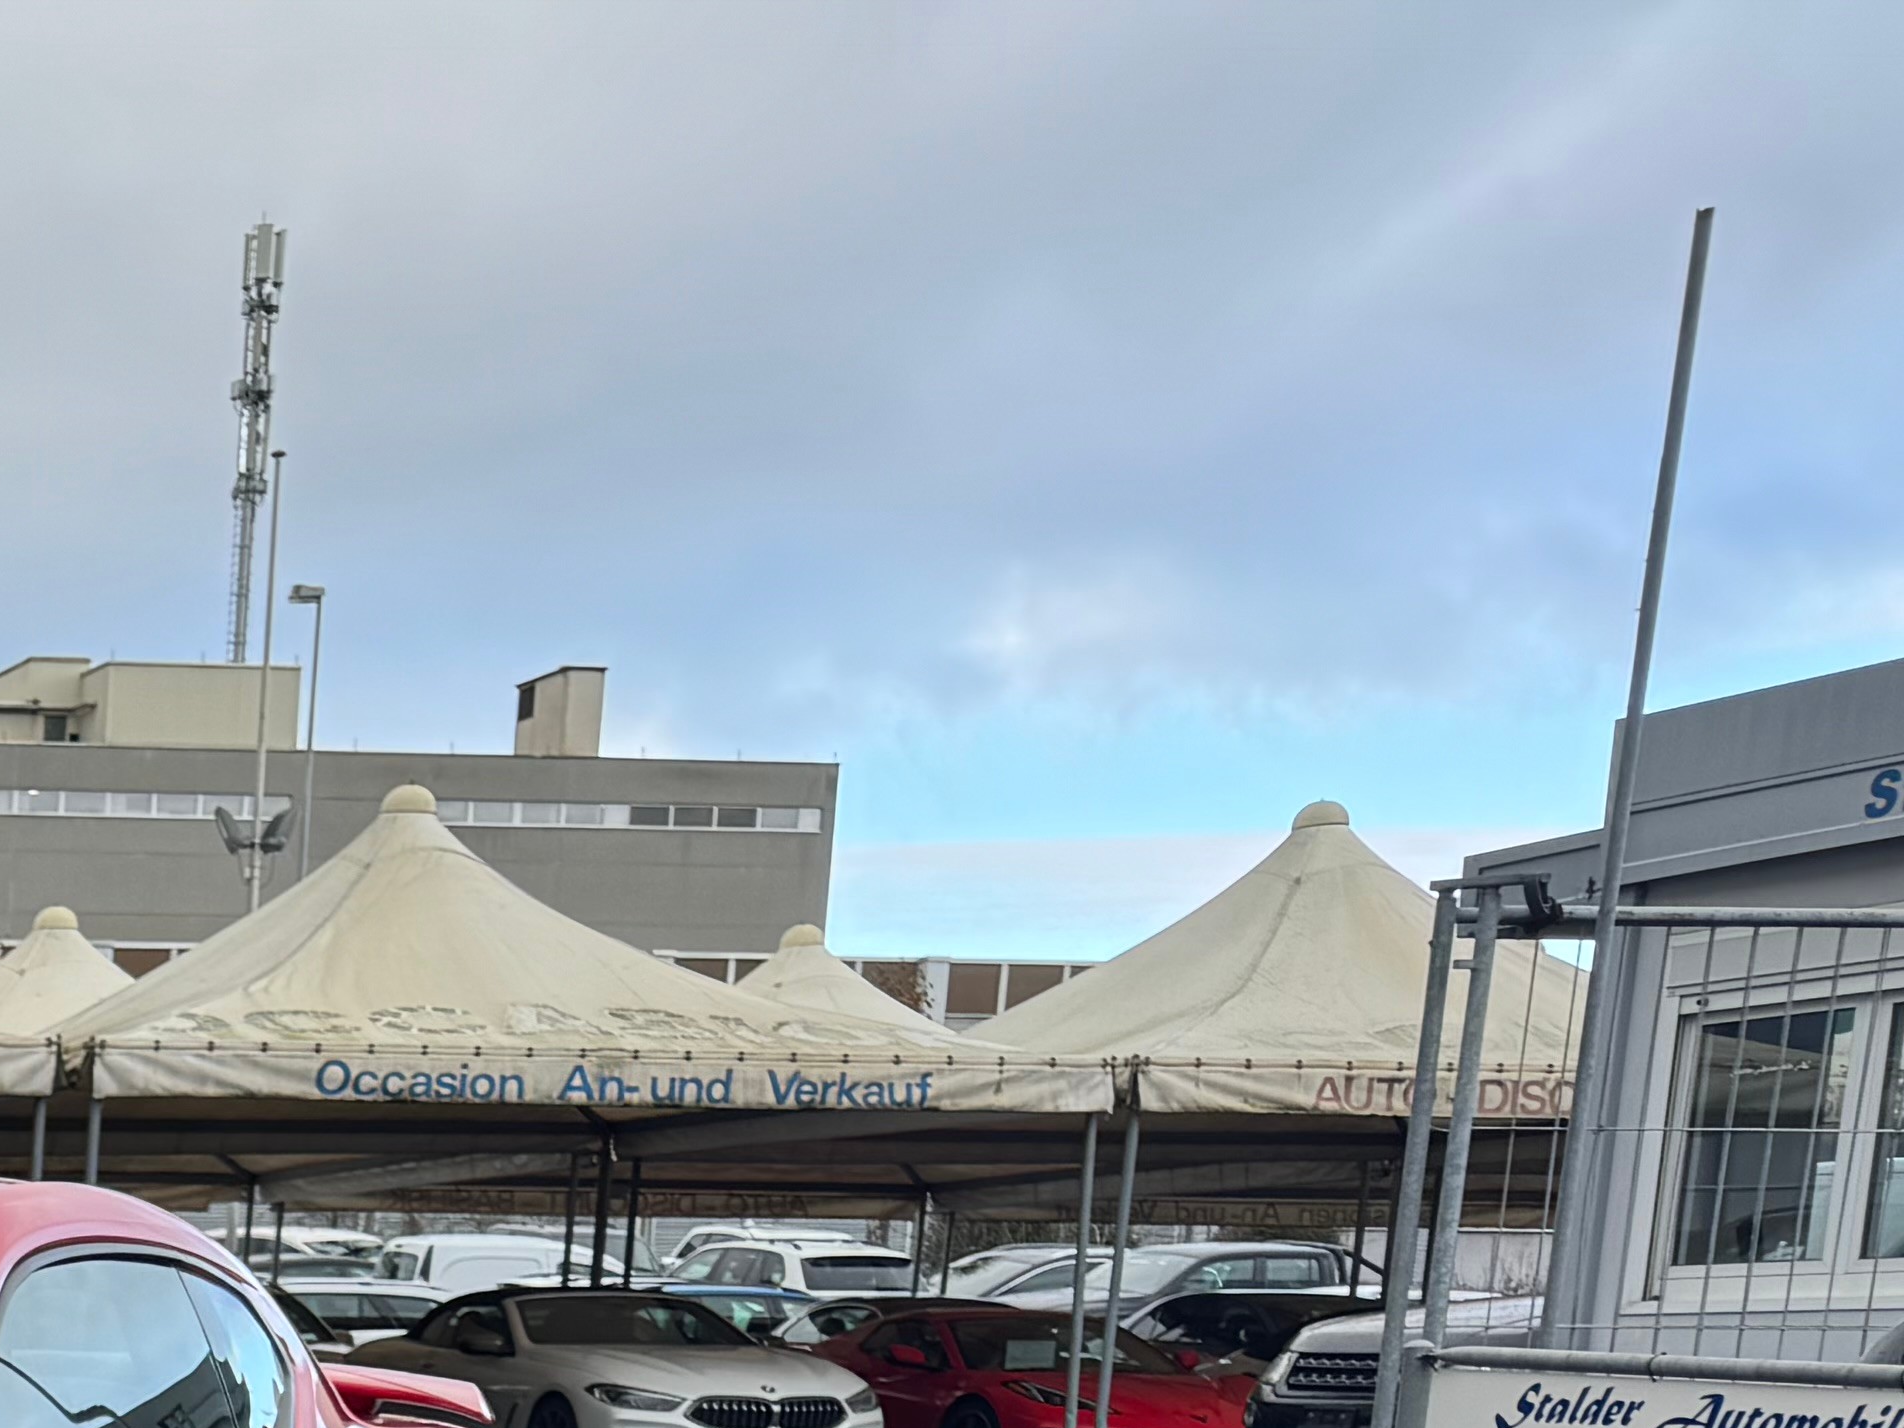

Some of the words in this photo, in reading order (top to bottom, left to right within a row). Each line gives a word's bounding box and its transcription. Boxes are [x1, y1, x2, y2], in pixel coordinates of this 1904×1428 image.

[1864, 769, 1904, 819] S
[315, 1060, 524, 1100] Occasion
[650, 1068, 734, 1105] und
[767, 1069, 934, 1110] Verkauf
